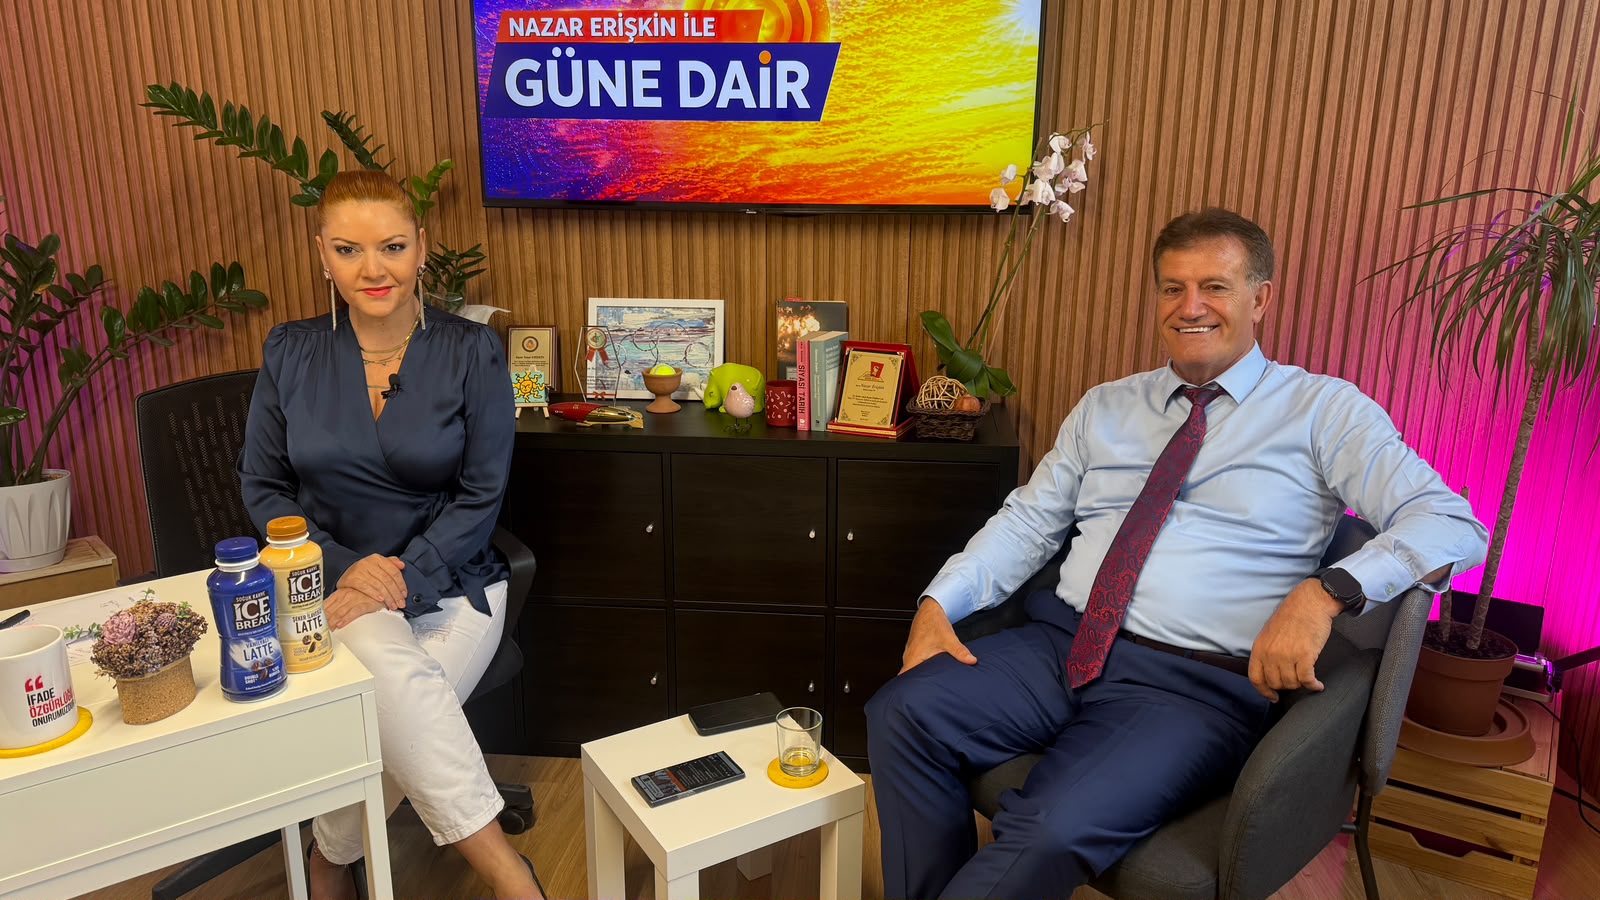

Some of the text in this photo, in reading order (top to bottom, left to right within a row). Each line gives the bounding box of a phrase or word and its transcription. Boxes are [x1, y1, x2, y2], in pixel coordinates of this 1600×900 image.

[508, 12, 716, 42] NAZAR ERİŞKİN İLE
[504, 46, 811, 109] GÜNE DAİR
[290, 588, 321, 604] BREAK
[235, 614, 271, 631] BREAK
[296, 615, 323, 634] LATTE
[243, 642, 274, 662] LATTE
[26, 687, 56, 706] İFADE
[29, 689, 73, 718] ÖZGÜRLÜĞ
